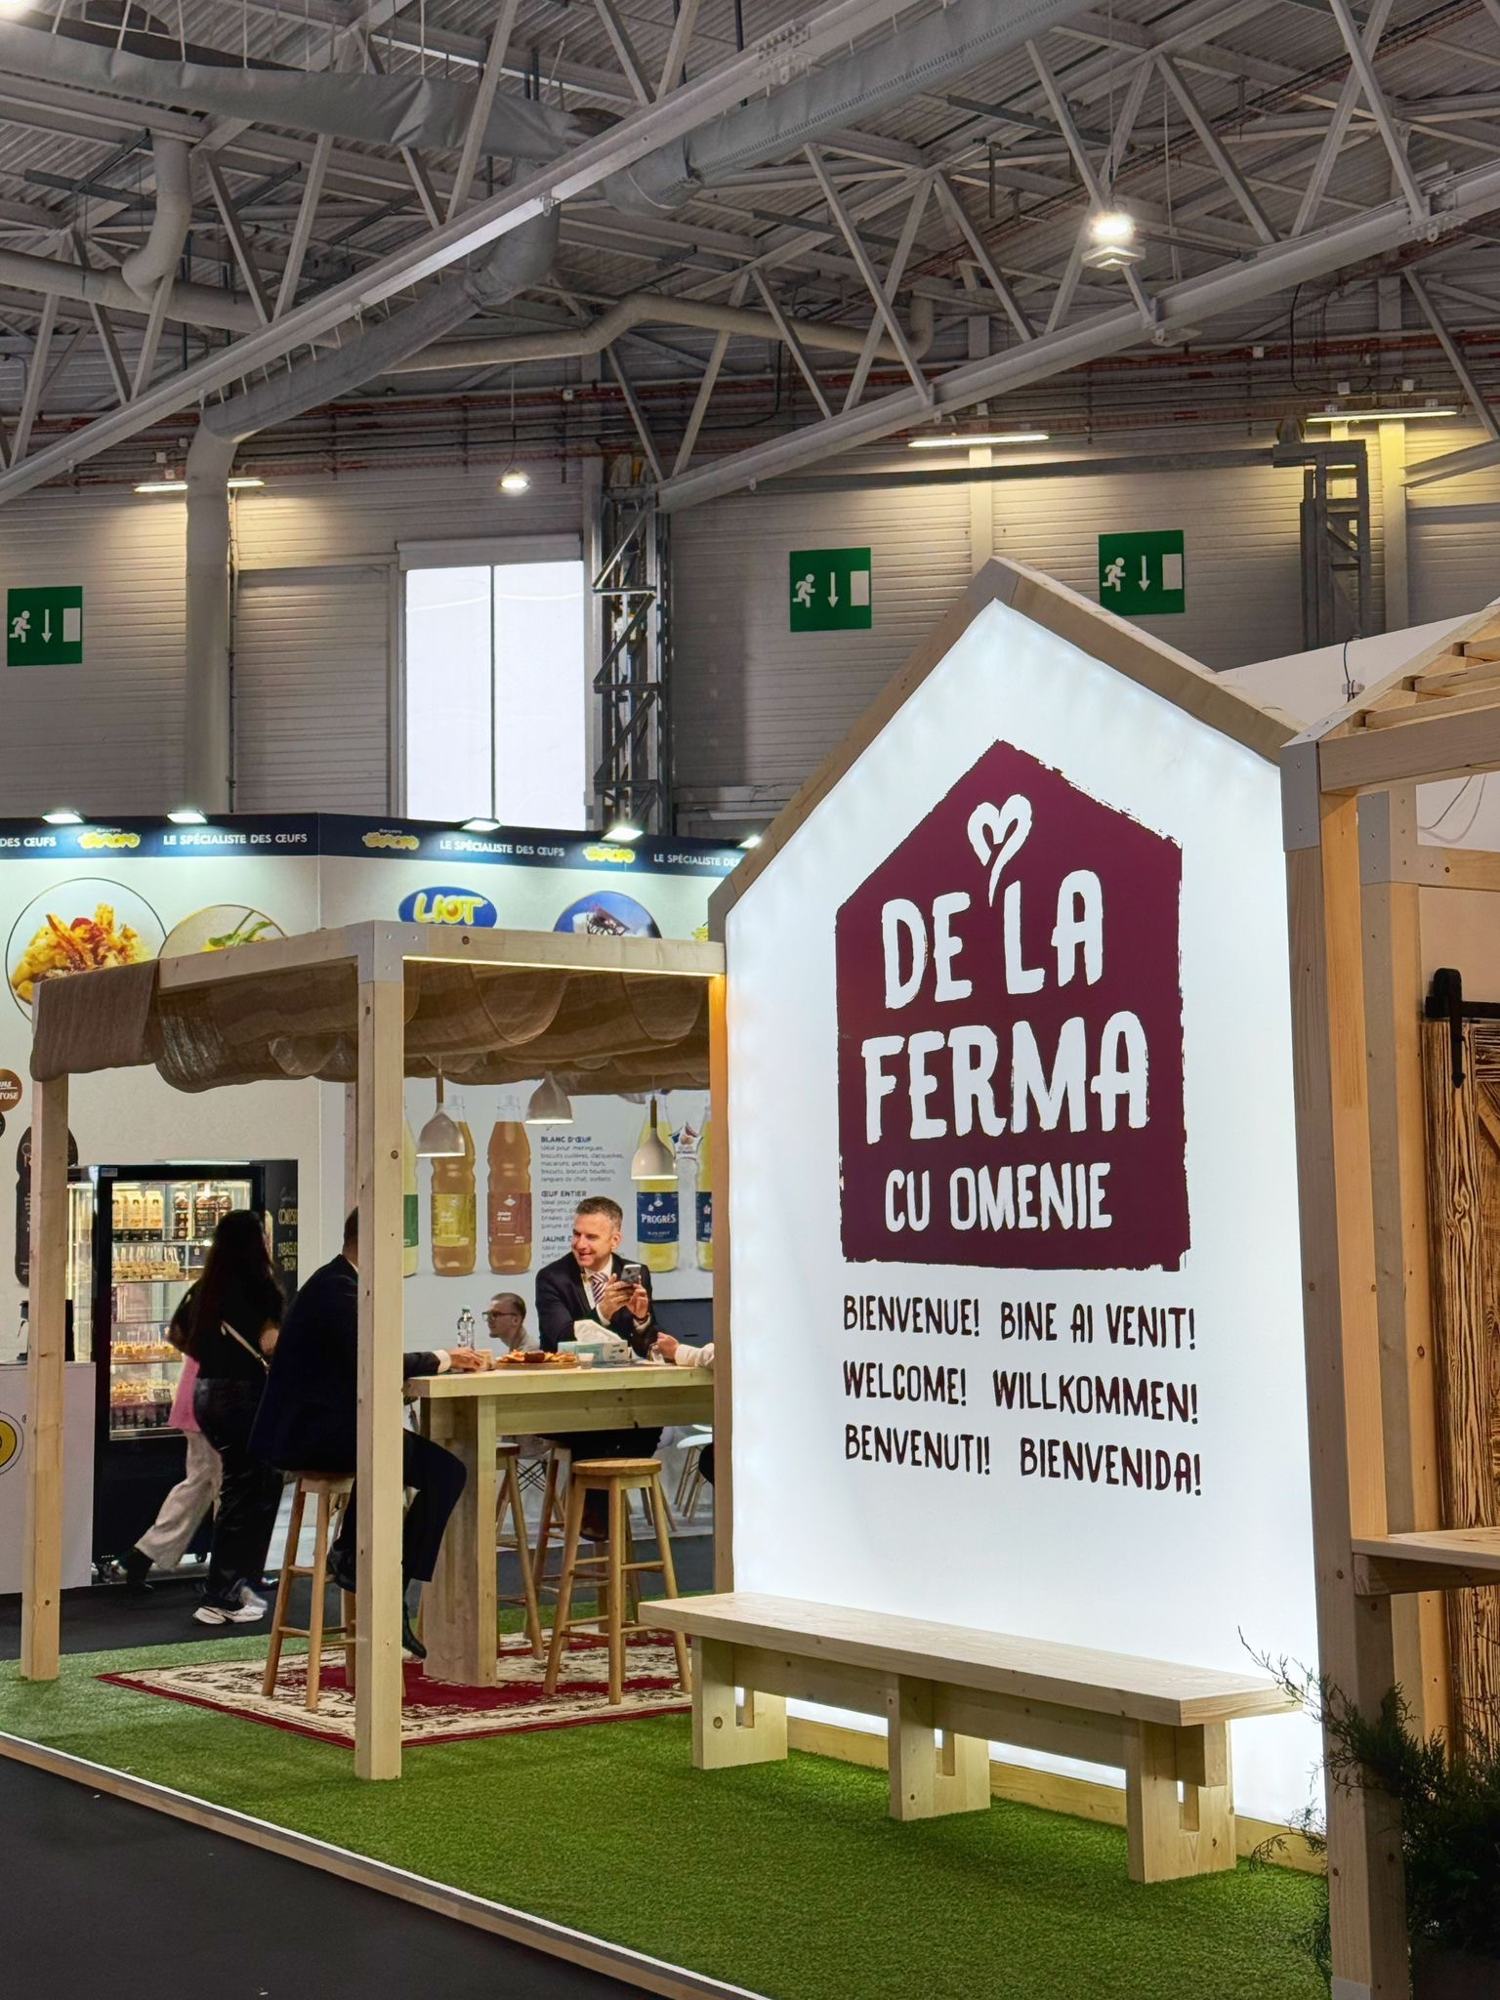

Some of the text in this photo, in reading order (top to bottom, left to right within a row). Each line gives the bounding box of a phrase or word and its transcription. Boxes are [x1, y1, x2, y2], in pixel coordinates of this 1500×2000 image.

[0, 836, 56, 847] DES ŒUFS
[163, 832, 308, 845] LE SPÉCIALISTE DES ŒUFS
[440, 839, 565, 857] LE SPÉCIALISTE DES ŒUFS
[653, 853, 664, 863] LE
[667, 852, 721, 866] SPÉCIALISTE
[413, 892, 488, 925] LIOT
[881, 869, 1103, 1009] DE LA
[861, 1010, 1151, 1144] FERMA
[885, 1162, 1112, 1232] CU OMENIE
[843, 1295, 1195, 1350] BIENVENUE! BINE AI VENIT!
[843, 1360, 1199, 1424] WELCOME! WILLKOMMEN!
[845, 1424, 1201, 1496] BENVENUTI! BIENVENIDA!
